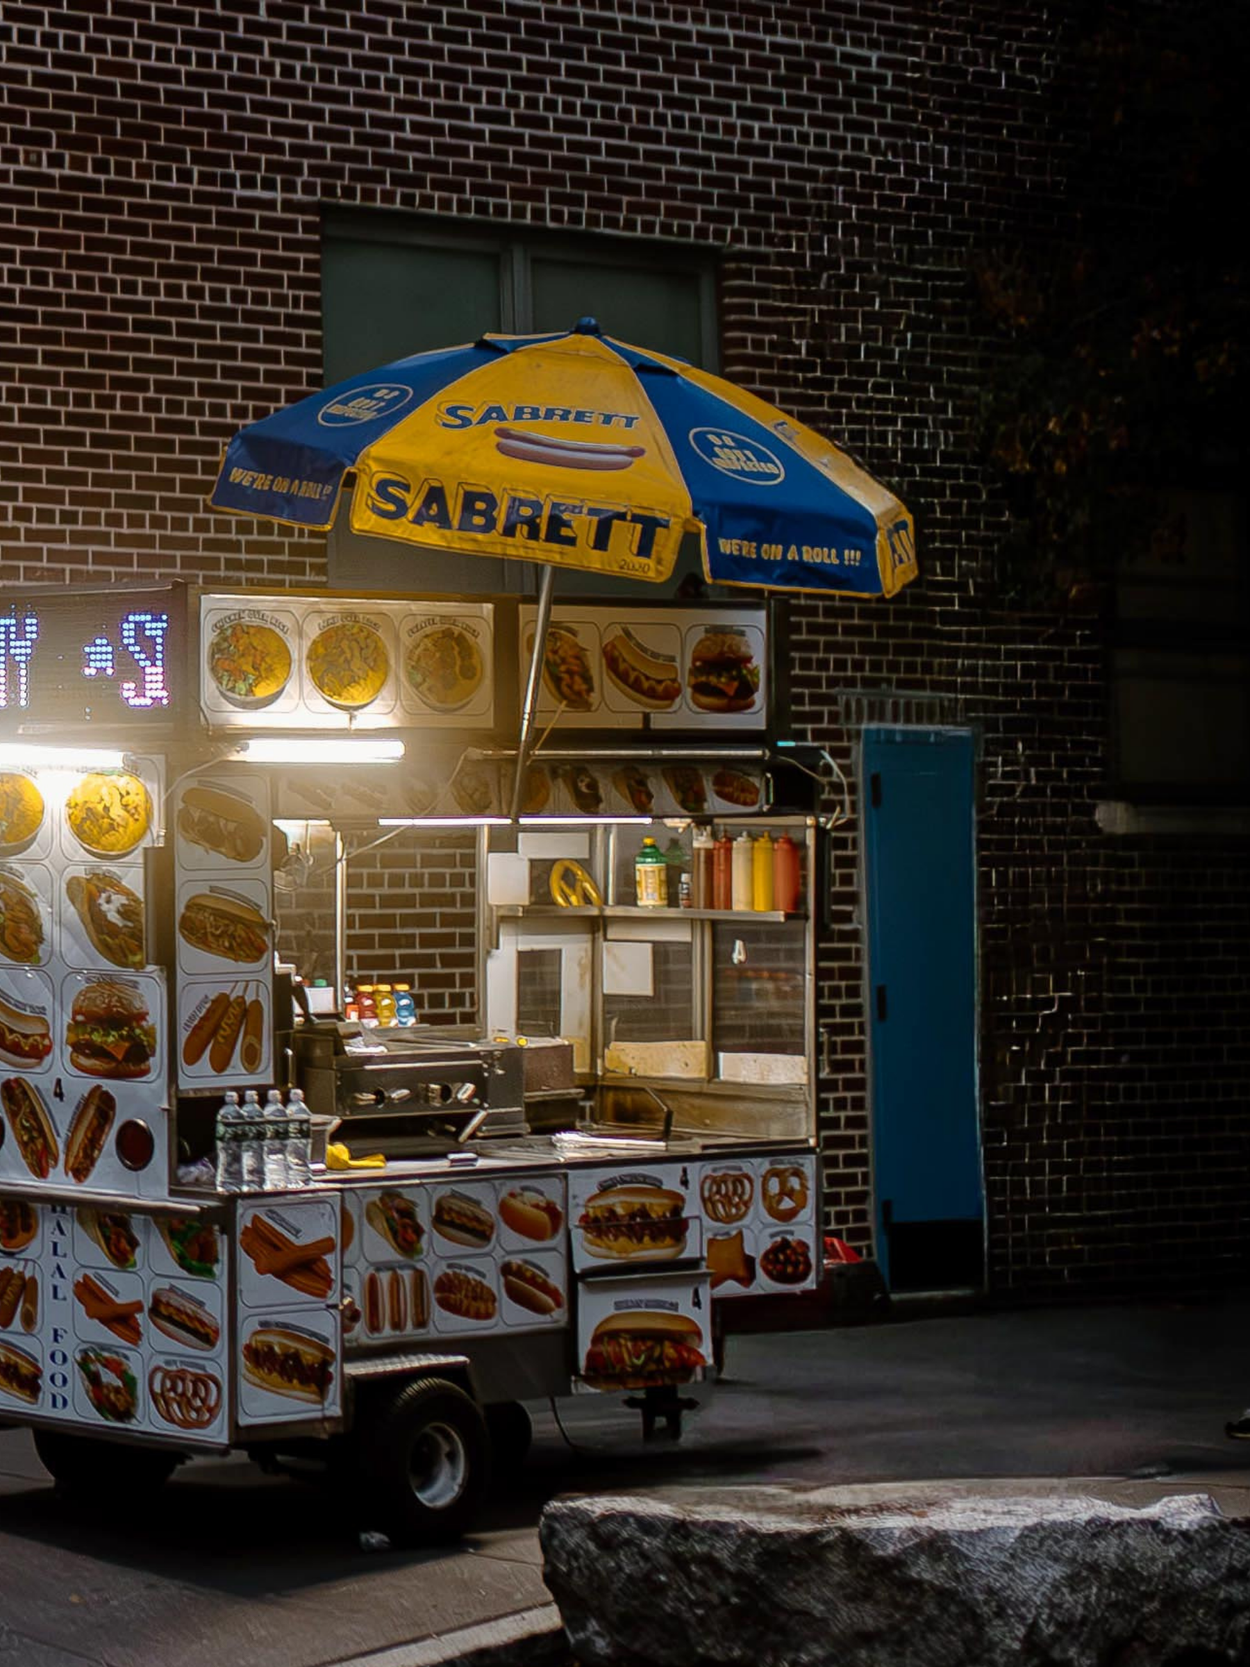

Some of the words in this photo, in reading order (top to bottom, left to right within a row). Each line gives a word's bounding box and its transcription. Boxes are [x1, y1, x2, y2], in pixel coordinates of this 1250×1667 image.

[437, 402, 640, 430] SABRETT
[367, 472, 671, 559] SABRETT
[761, 543, 783, 560] ON
[787, 544, 799, 561] A
[802, 546, 840, 565] ROLL
[49, 1327, 69, 1411] FOOD
